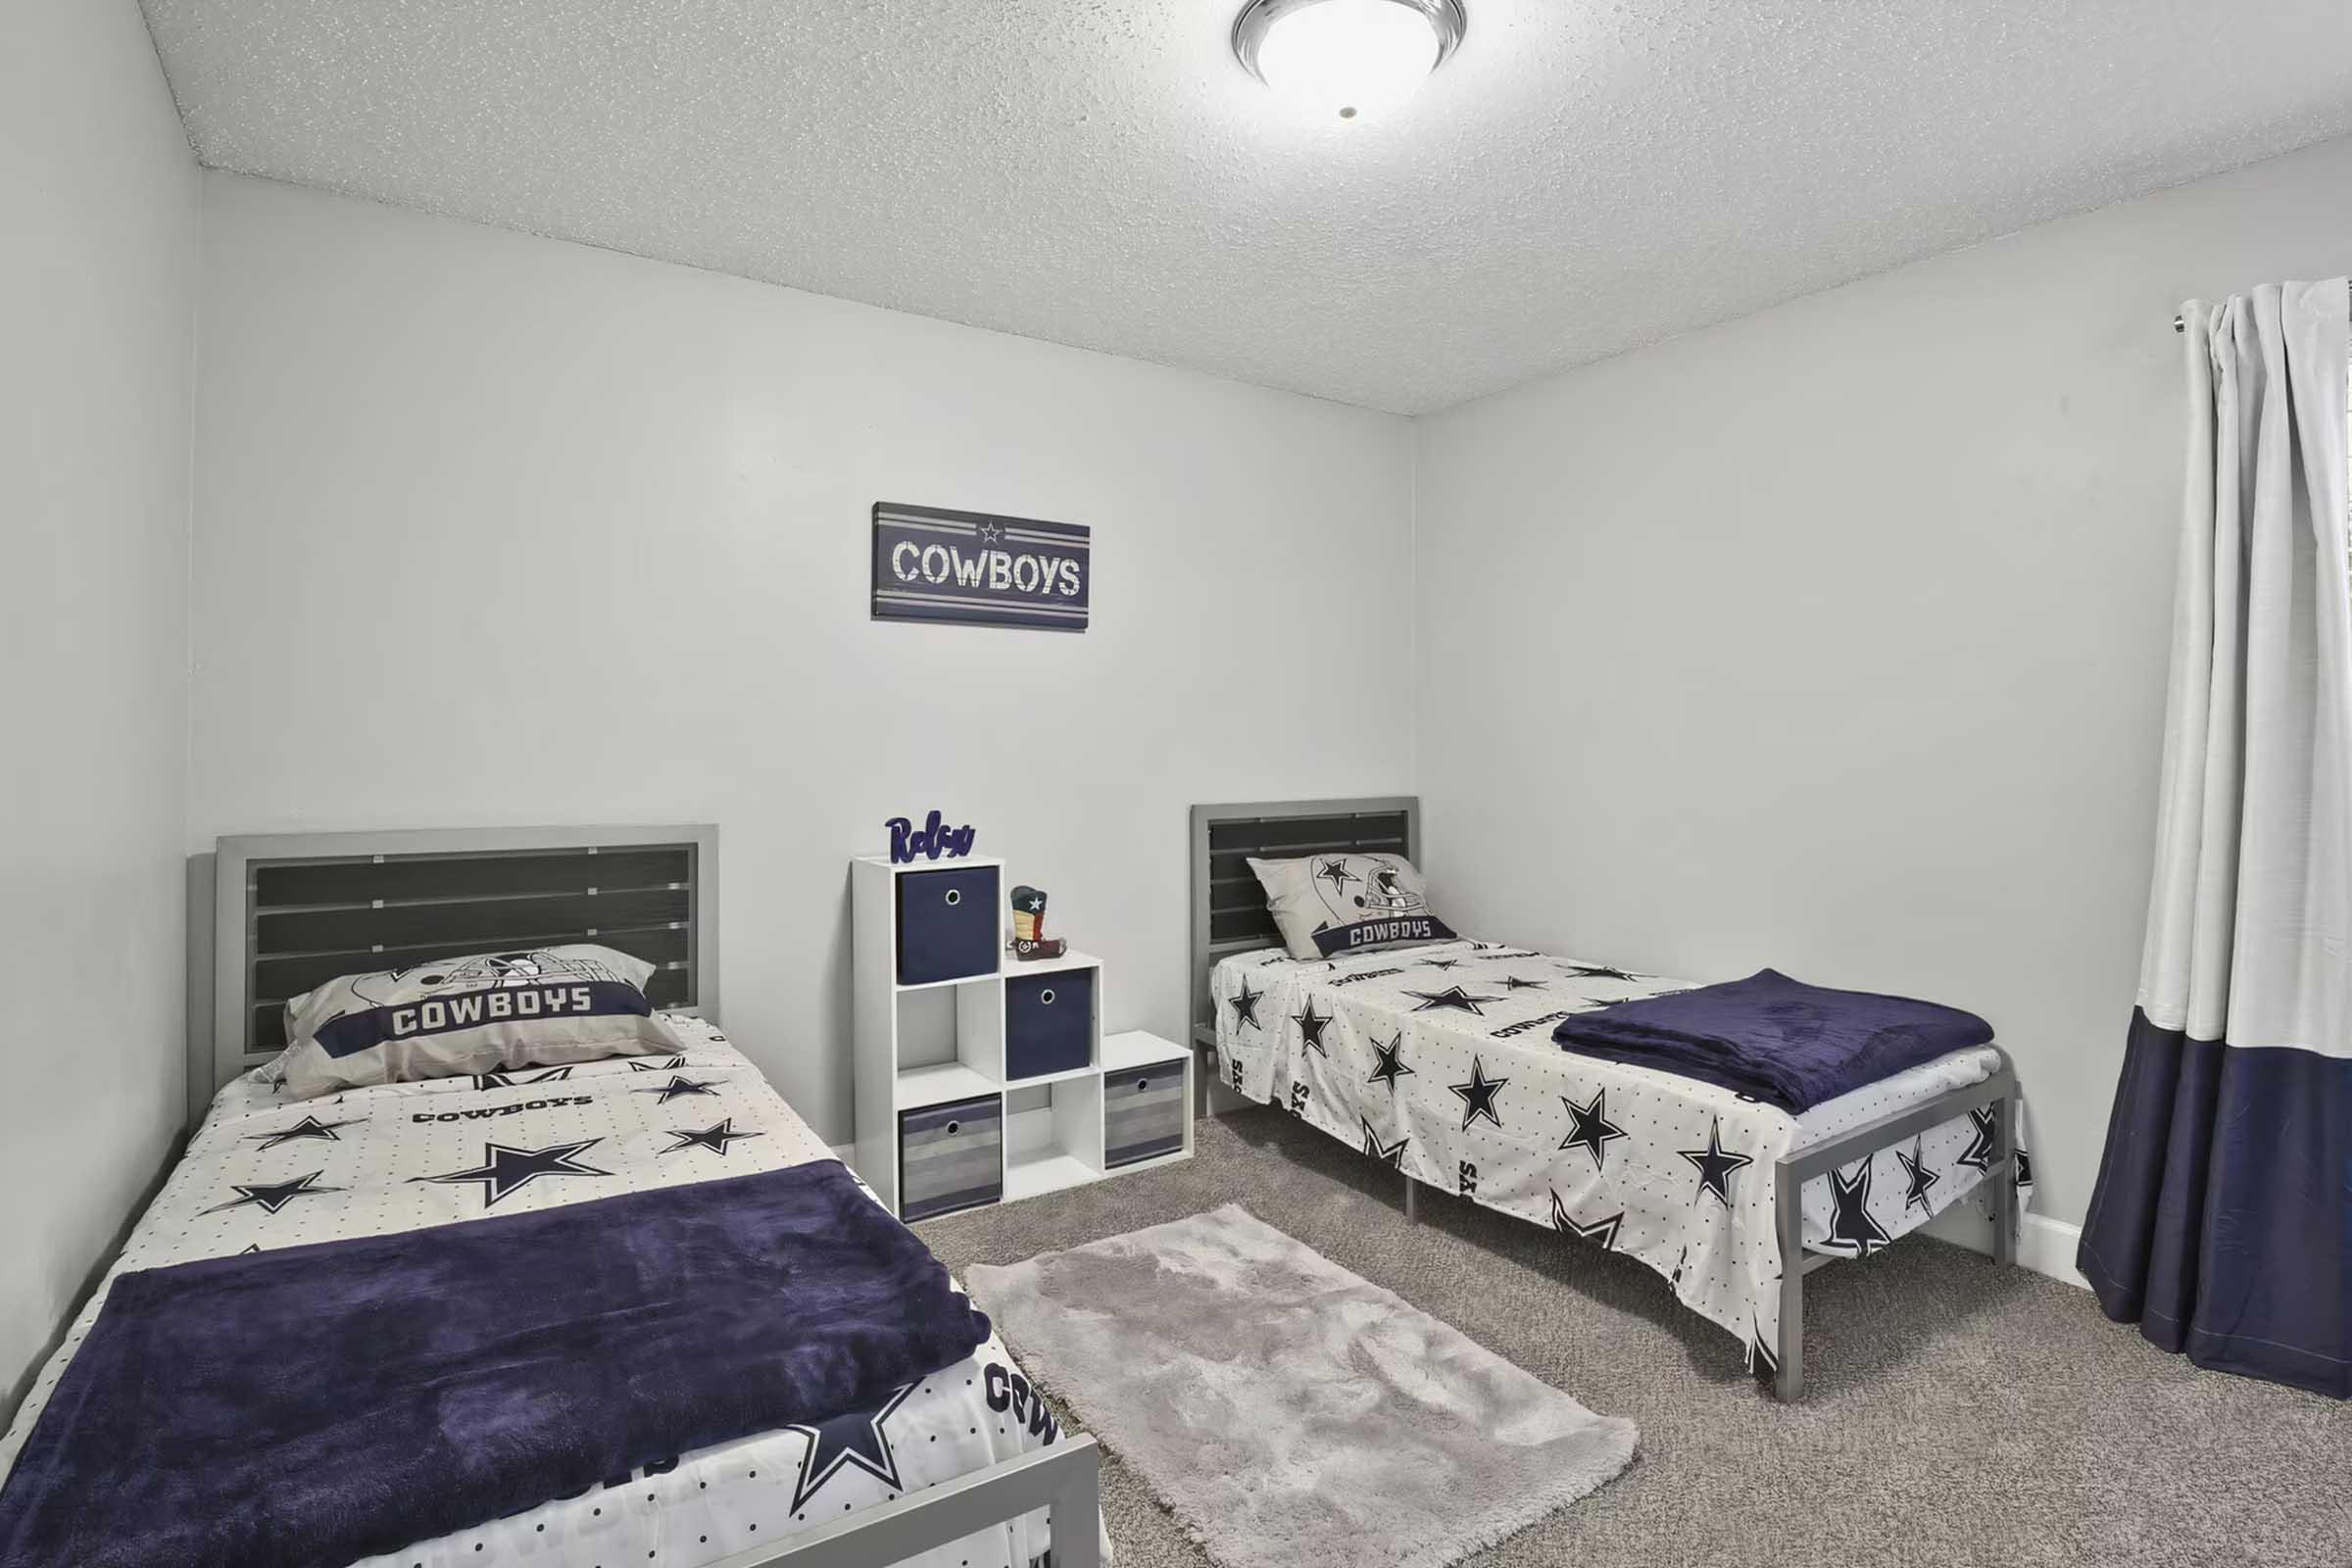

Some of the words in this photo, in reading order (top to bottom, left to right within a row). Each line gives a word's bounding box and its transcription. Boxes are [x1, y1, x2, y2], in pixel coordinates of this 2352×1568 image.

[892, 540, 1081, 596] COWBOYS
[1349, 920, 1431, 947] COWBOYS
[393, 986, 592, 1036] COWBOYS
[412, 1095, 593, 1123] COWBOYS
